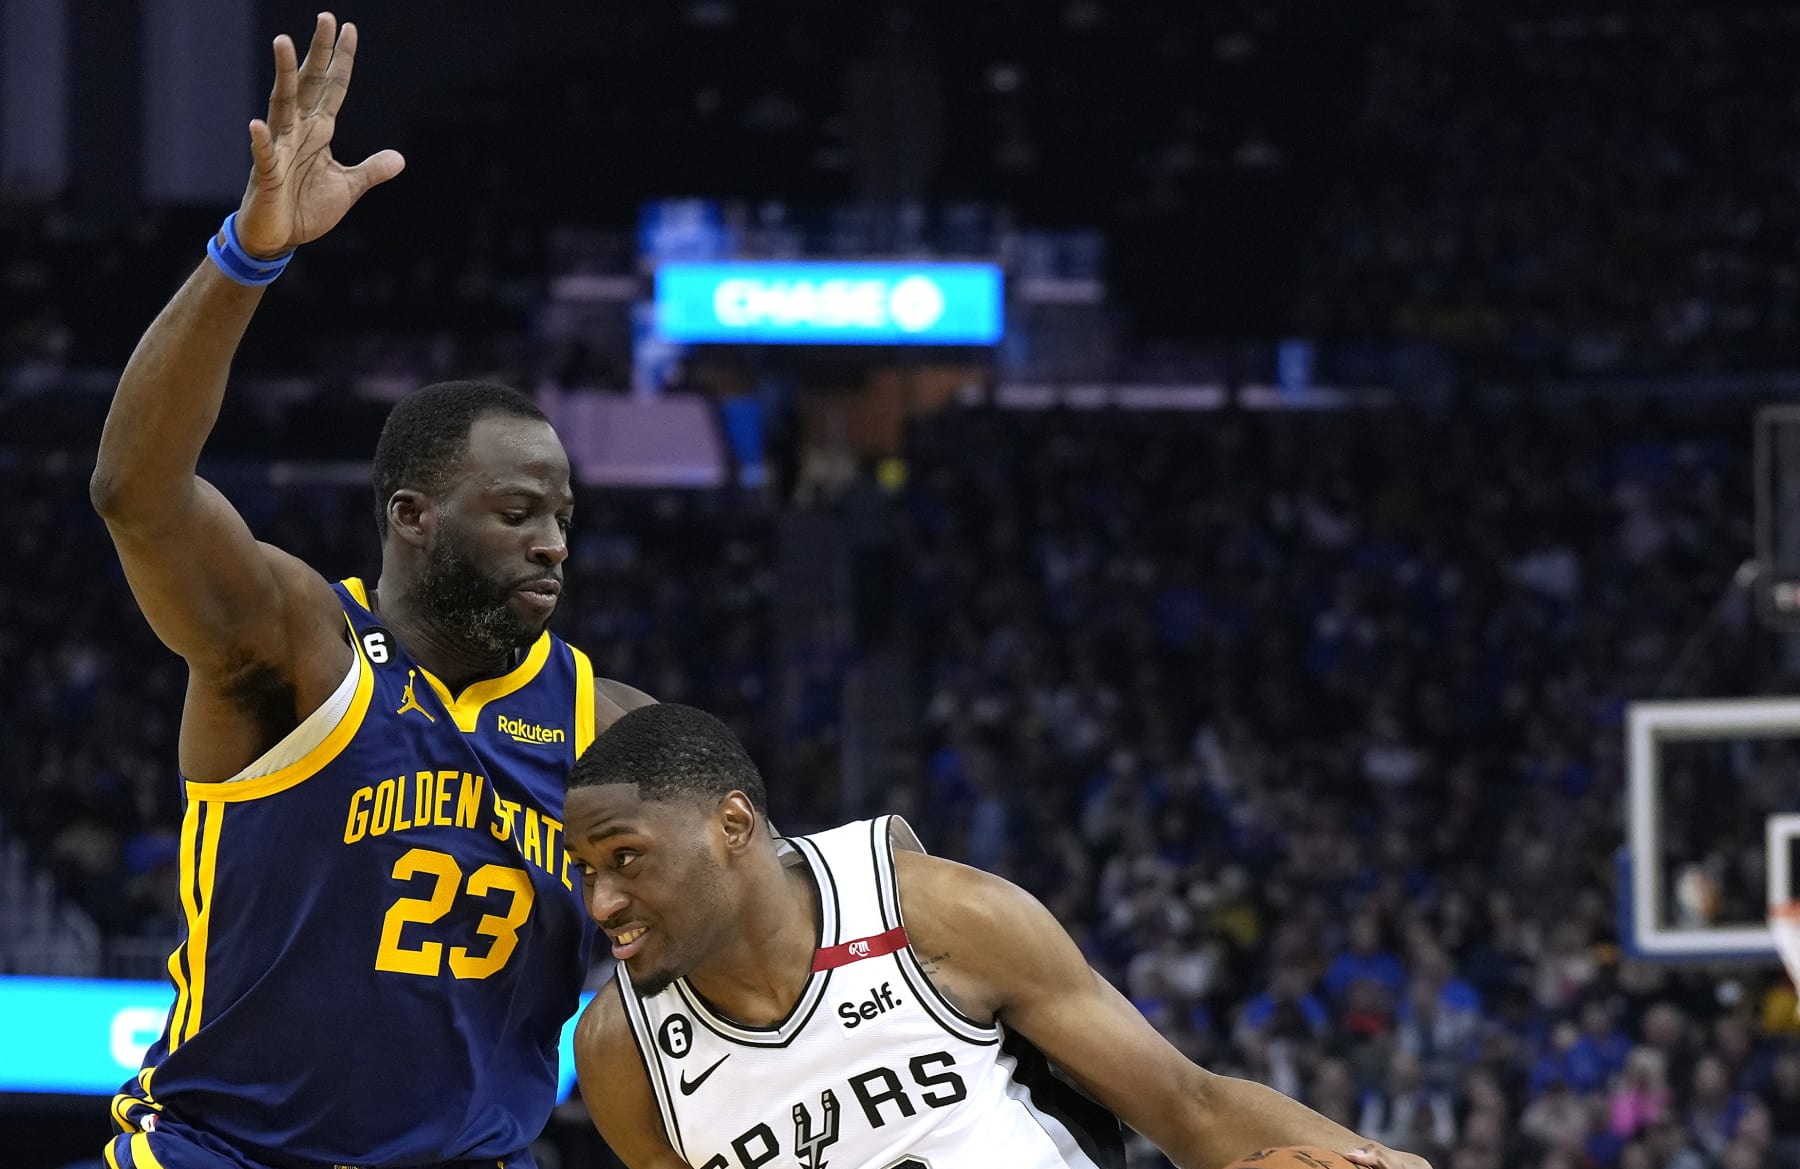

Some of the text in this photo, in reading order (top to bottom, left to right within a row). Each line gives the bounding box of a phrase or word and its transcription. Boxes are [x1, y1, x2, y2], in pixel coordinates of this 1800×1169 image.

[363, 631, 390, 663] 6
[498, 714, 565, 744] Rakuten
[343, 771, 484, 845] GOLDEN
[375, 848, 535, 980] 23
[838, 981, 902, 1029] Self.
[667, 1019, 687, 1053] 6
